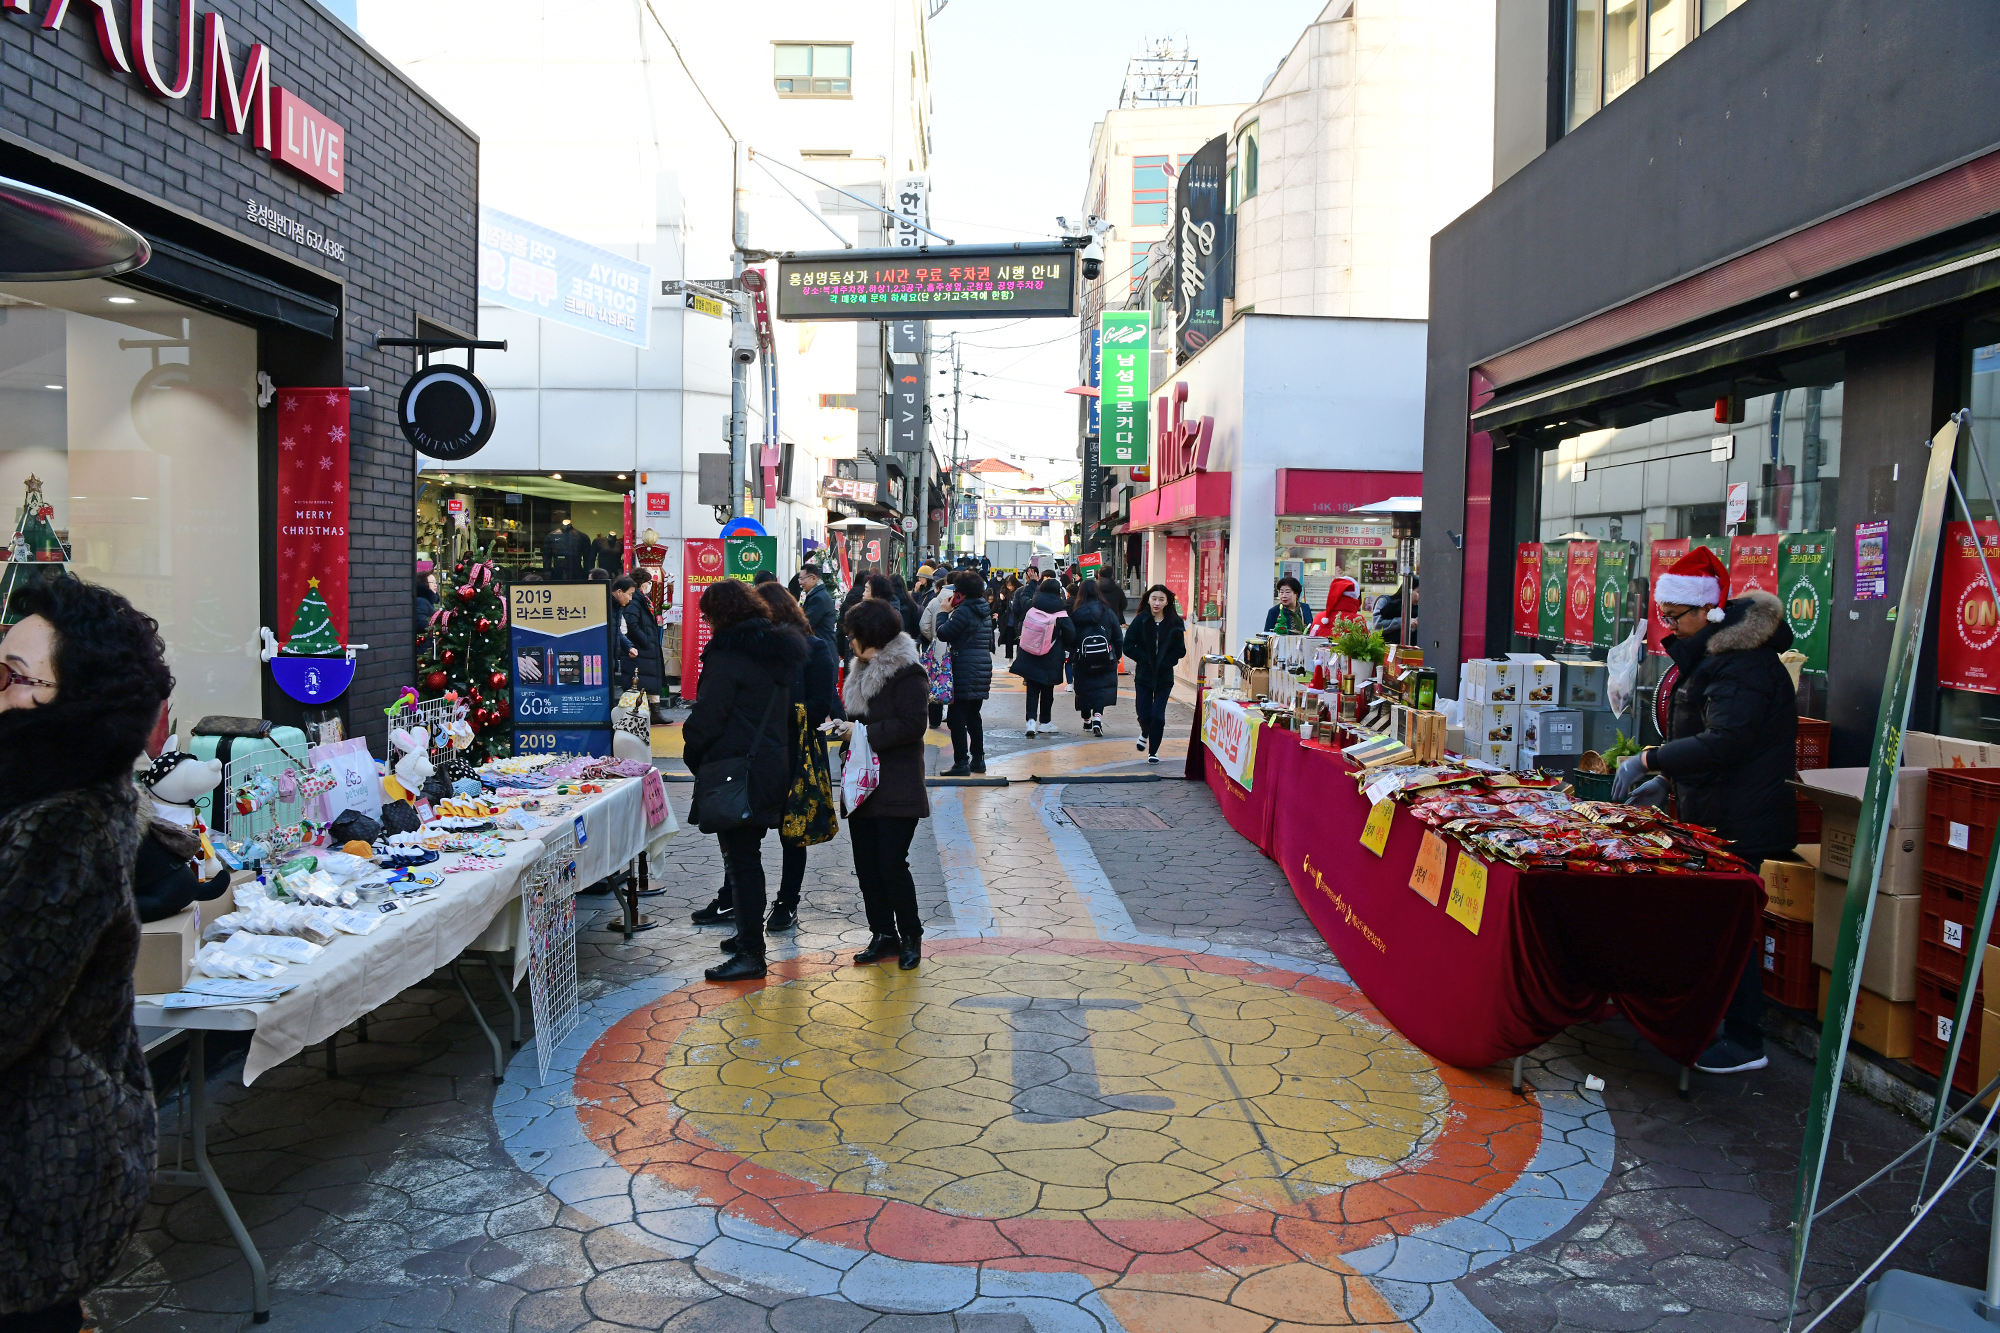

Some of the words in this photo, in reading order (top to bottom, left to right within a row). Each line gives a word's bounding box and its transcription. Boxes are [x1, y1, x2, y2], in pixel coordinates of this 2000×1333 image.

[288, 105, 339, 178] LIVE
[247, 198, 304, 244] 홍성일번가점
[789, 270, 868, 287] 홍성명동상가
[875, 269, 910, 284] 1시간
[916, 268, 943, 283] 무료
[949, 266, 991, 281] 주차권
[997, 265, 1026, 281] 시행
[1032, 264, 1061, 280] 안내
[997, 280, 1044, 291] 공영주차장
[830, 294, 838, 304] 각
[841, 294, 867, 304] 매장에
[871, 293, 887, 303] 문의
[992, 290, 1015, 301] 한함)
[1196, 309, 1215, 319] 라떼
[1116, 354, 1135, 460] 남성크로커다일
[902, 393, 915, 441] PAT
[411, 426, 472, 452] ARITAUM
[296, 510, 333, 520] MERRY
[282, 525, 344, 536] CHRISTMAS
[1346, 537, 1376, 546] A/S합니다
[702, 554, 719, 564] ON
[742, 552, 759, 562] ON
[1740, 555, 1768, 564] 크리스마스마켓
[1790, 554, 1822, 564] 크리스마스마켓
[1364, 563, 1373, 573] 귀
[516, 590, 552, 604] 2019
[1522, 587, 1534, 600] ON
[1548, 587, 1559, 602] ON
[1574, 589, 1587, 605] ON
[517, 607, 554, 621] 라스트
[557, 606, 586, 621] 찬스!
[1791, 598, 1815, 620] ON
[1964, 599, 1998, 627] ON
[543, 706, 559, 715] OFF
[519, 734, 556, 749] 2019
